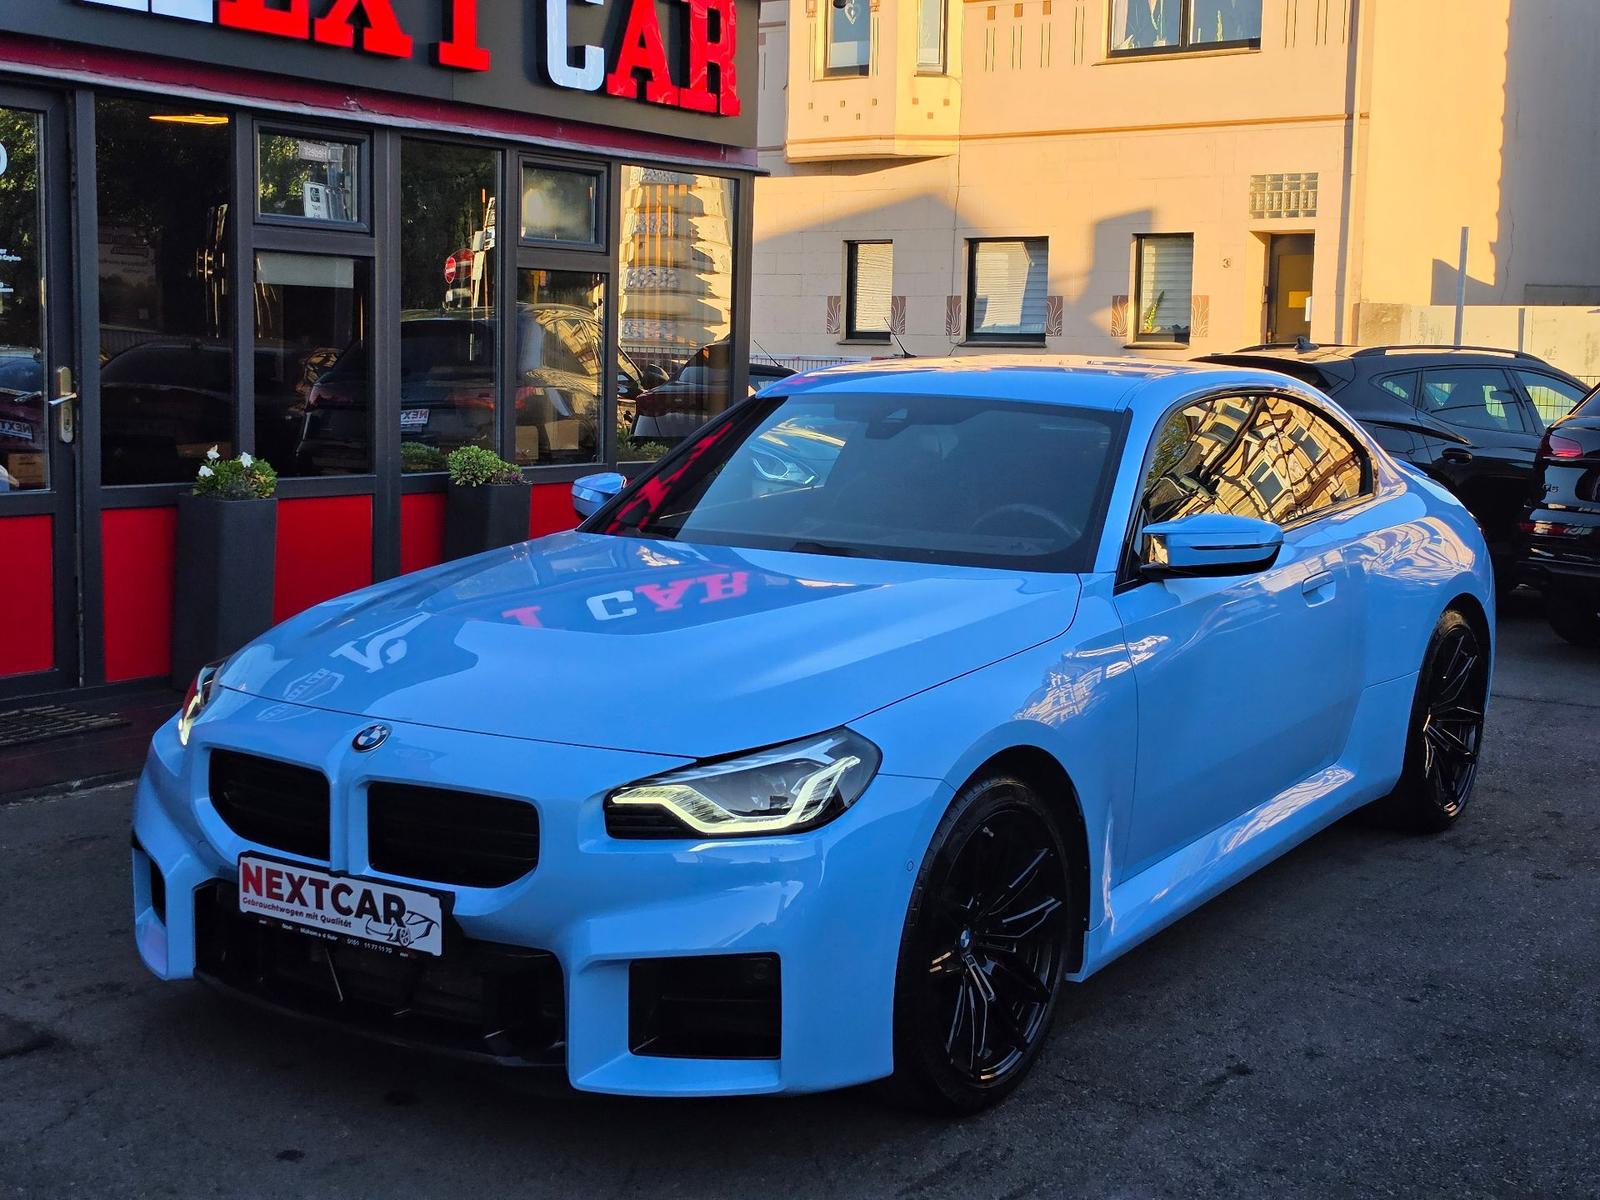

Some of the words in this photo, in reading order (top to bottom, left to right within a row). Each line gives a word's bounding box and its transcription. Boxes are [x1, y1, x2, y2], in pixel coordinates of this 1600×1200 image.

[546, 0, 741, 117] CAR
[1222, 258, 1231, 268] 3
[241, 862, 406, 929] NEXTCAR
[242, 897, 304, 918] Gebrauchtwagen
[305, 912, 319, 921] mit
[320, 914, 352, 928] Qualität
